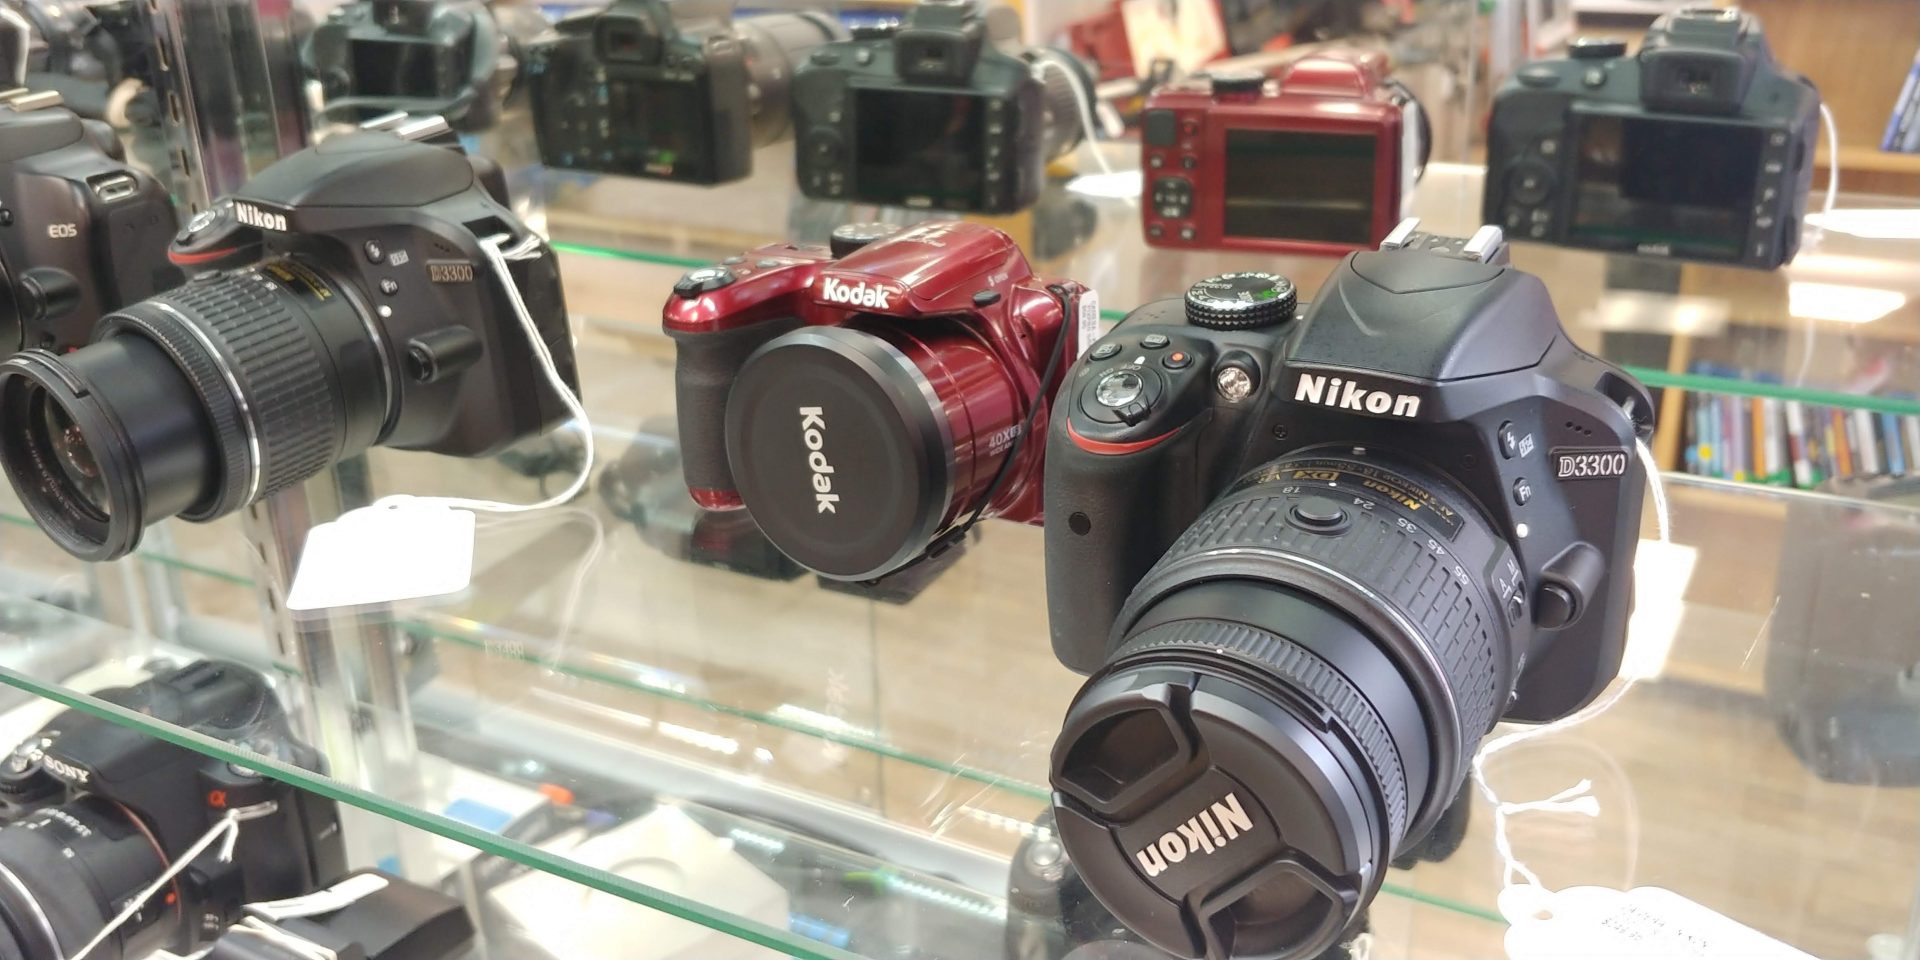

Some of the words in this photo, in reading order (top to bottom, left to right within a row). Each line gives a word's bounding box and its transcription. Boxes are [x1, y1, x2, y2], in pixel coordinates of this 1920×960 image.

[236, 202, 288, 232] Nikon
[48, 222, 78, 238] EOS
[430, 264, 473, 282] D3300
[823, 277, 890, 309] Kodak
[1295, 373, 1420, 418] Nikon
[799, 406, 840, 514] Kodak
[1558, 453, 1626, 477] D3300
[1282, 486, 1301, 495] 18
[1363, 480, 1421, 511] Nikon
[1519, 485, 1532, 502] Fn
[1353, 497, 1376, 511] 24
[1397, 517, 1418, 534] 35
[1427, 539, 1446, 557] 45
[1454, 565, 1470, 586] 55
[43, 755, 89, 783] SONY
[1136, 792, 1254, 877] Nikon
